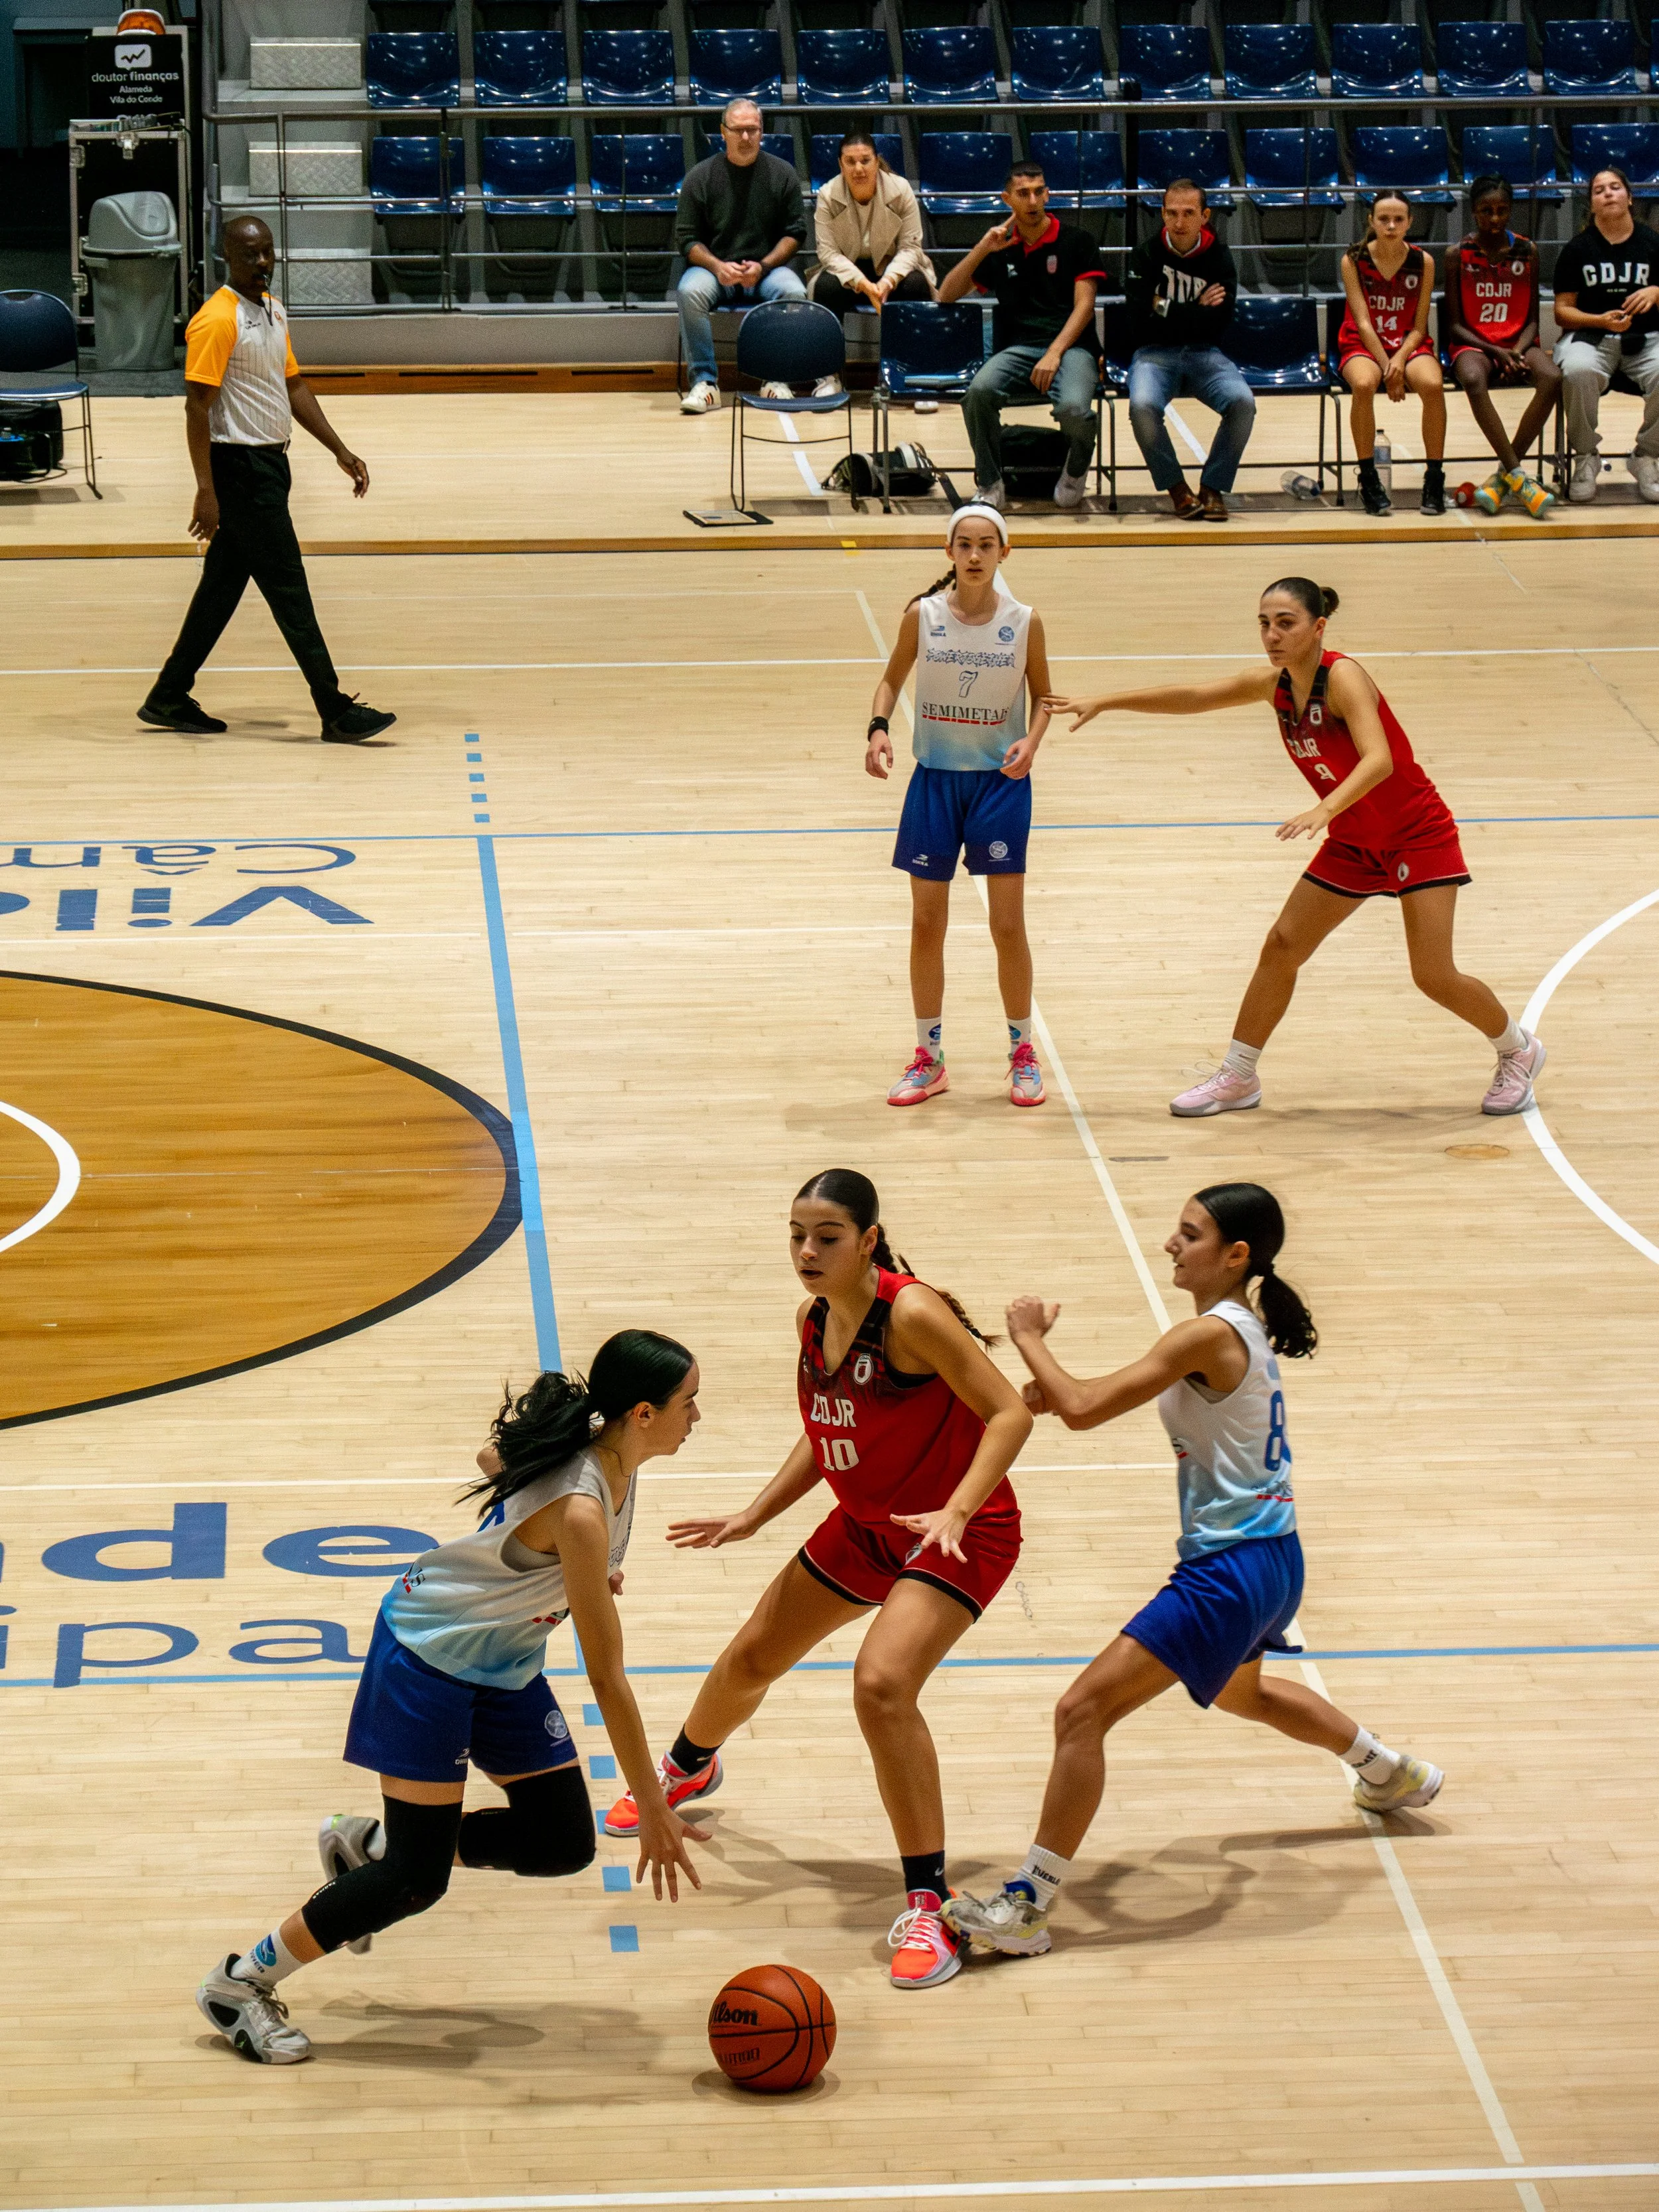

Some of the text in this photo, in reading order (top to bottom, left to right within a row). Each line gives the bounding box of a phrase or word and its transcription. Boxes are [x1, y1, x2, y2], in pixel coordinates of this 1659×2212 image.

[92, 71, 179, 83] doutor finanças
[119, 85, 153, 94] Alameda
[126, 95, 137, 104] do
[1582, 262, 1650, 287] CDJR
[1476, 282, 1512, 298] CDJR
[1368, 295, 1406, 312] CDJR
[1479, 303, 1508, 323] 20
[1375, 315, 1398, 333] 14
[959, 670, 979, 698] 7
[810, 1393, 857, 1427] CDJR
[1264, 1390, 1289, 1472] 8
[819, 1436, 859, 1472] 10
